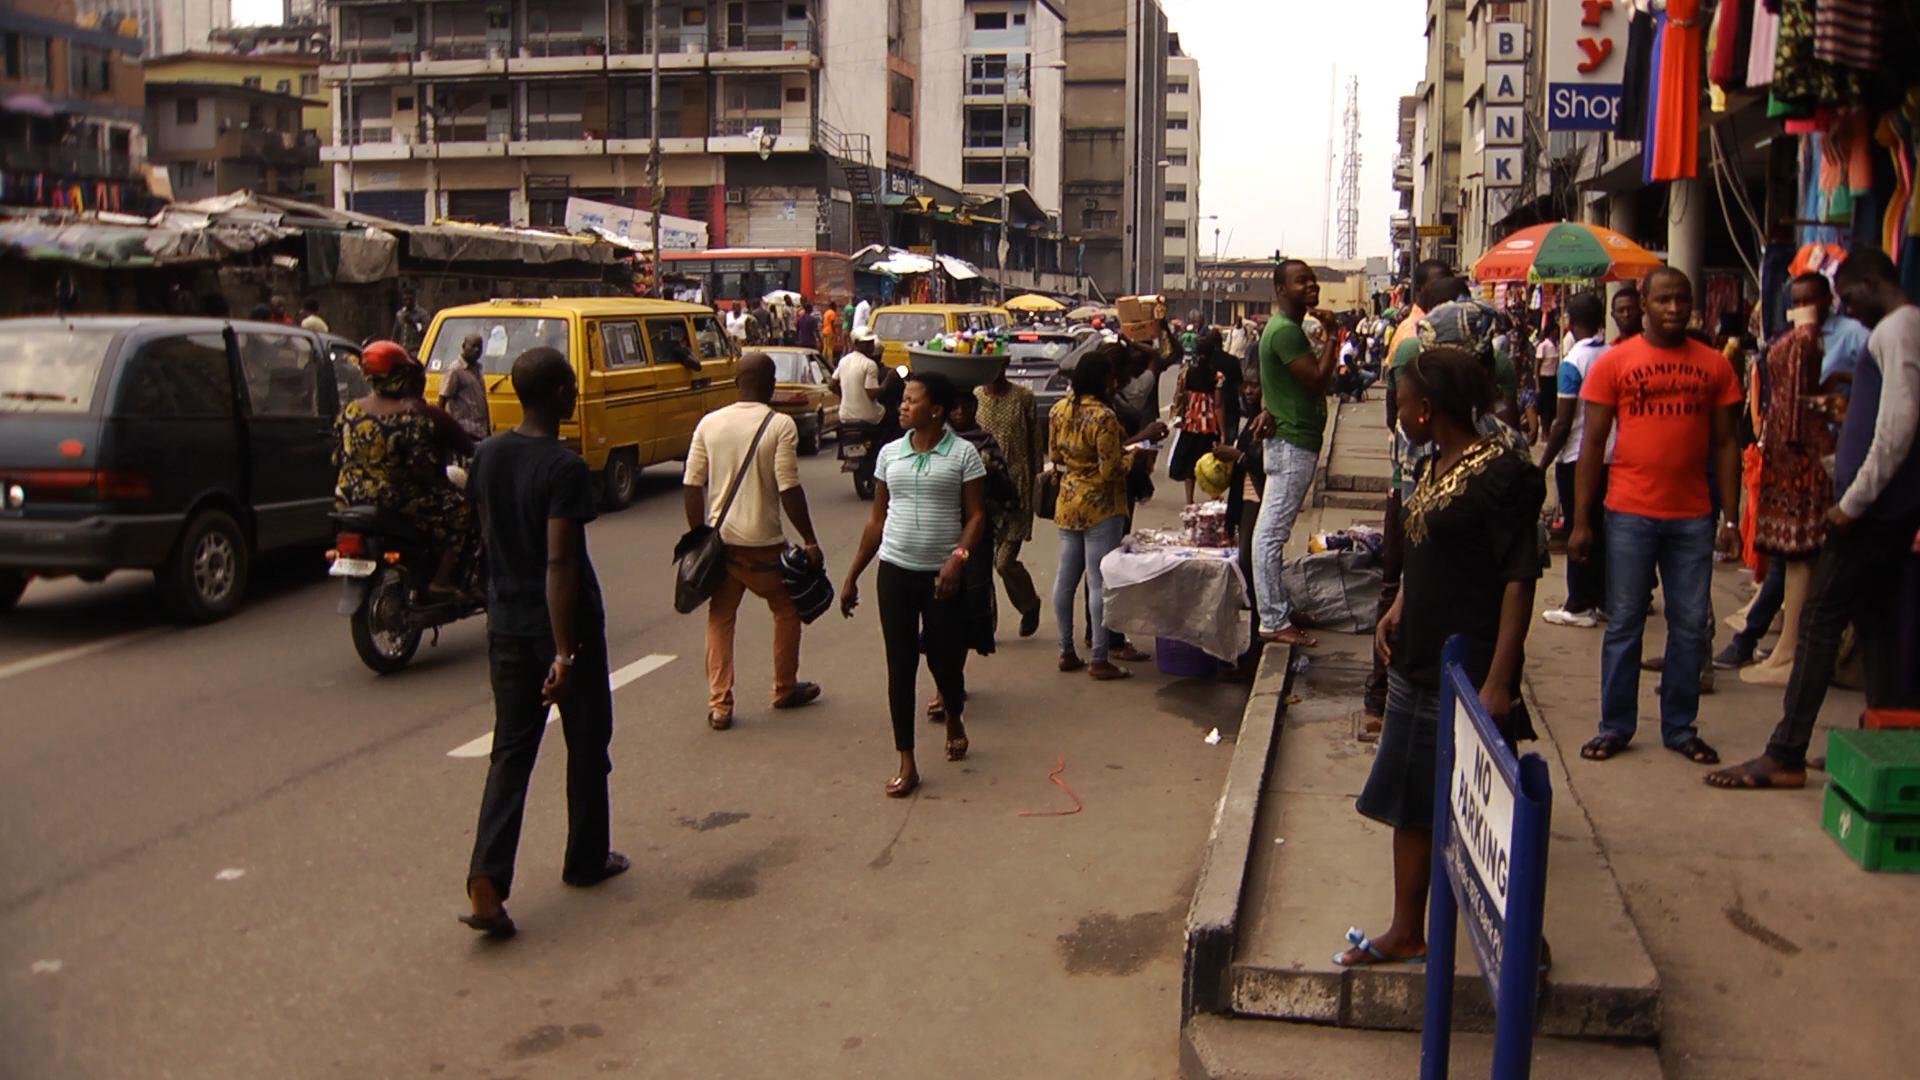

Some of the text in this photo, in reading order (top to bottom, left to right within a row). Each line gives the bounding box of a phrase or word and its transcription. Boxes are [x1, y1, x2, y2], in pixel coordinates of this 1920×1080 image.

[1496, 32, 1515, 181] BANK
[1625, 363, 1710, 386] CHAMPIONS
[1629, 402, 1704, 416] DIVISION
[1474, 745, 1492, 807] NO
[1456, 768, 1508, 898] PARKING
